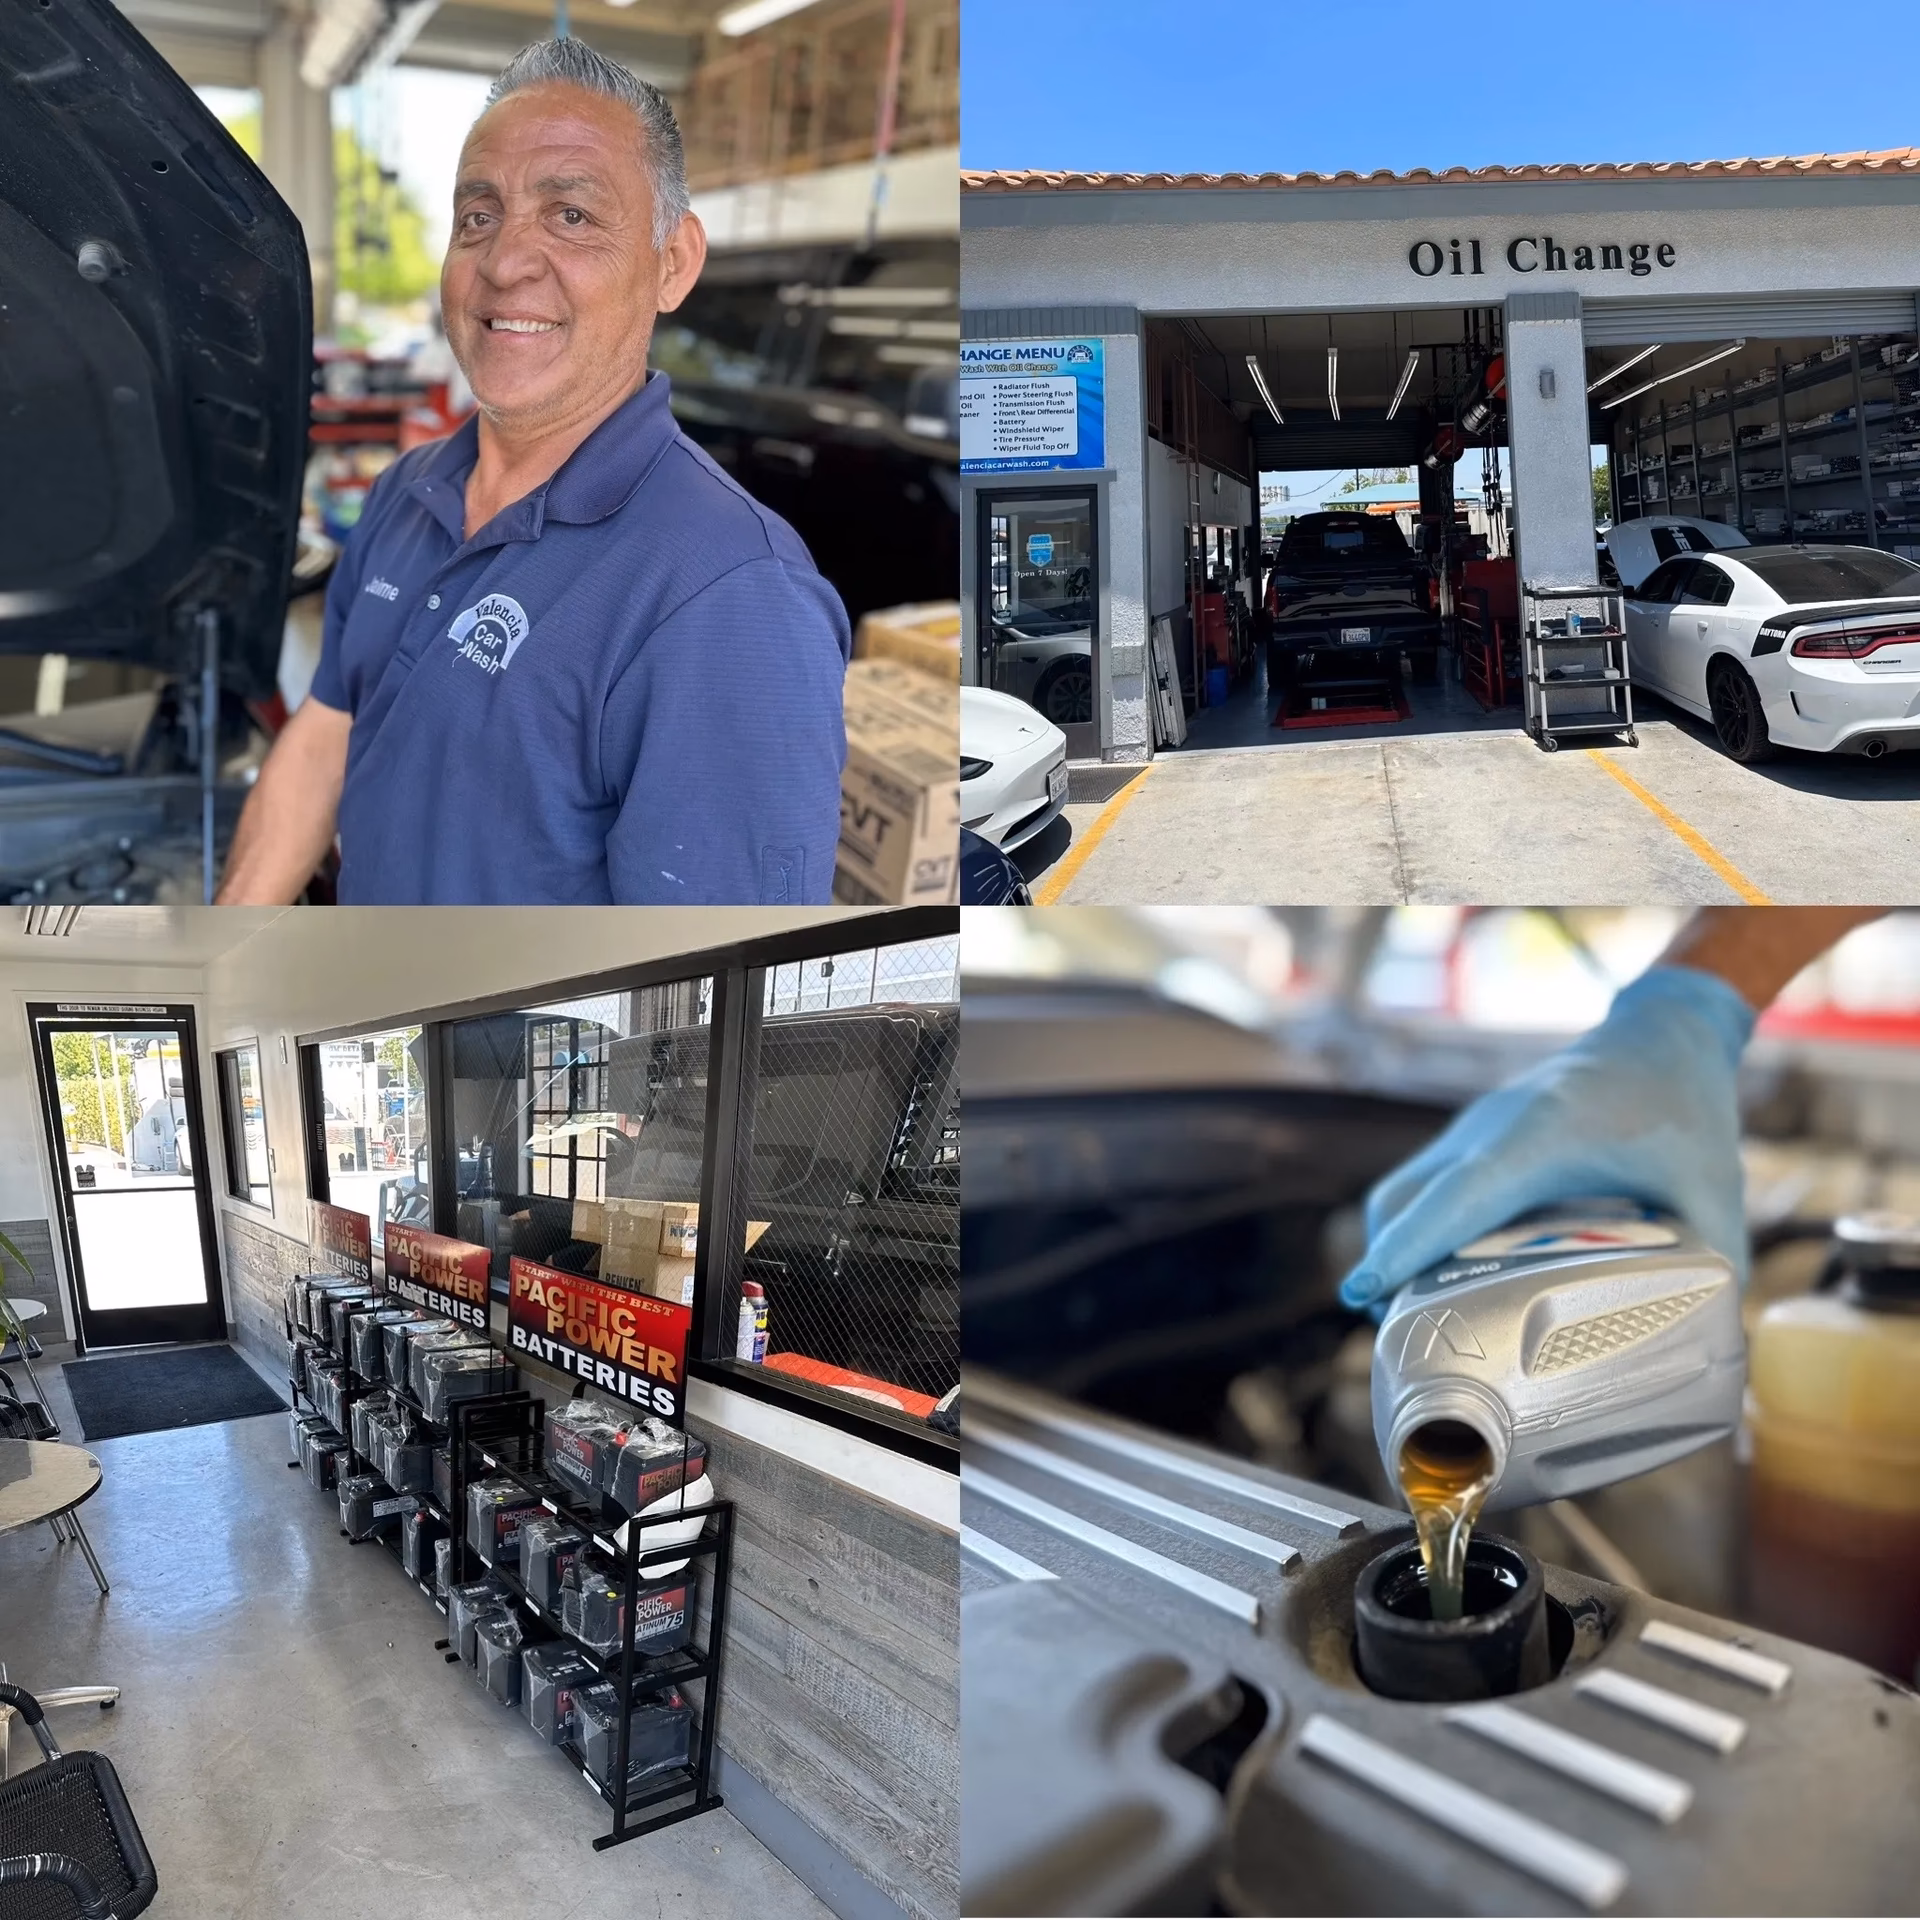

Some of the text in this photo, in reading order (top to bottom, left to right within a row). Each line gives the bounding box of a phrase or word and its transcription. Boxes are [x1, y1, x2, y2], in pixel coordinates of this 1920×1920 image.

[1408, 237, 1676, 276] Oil Change
[1016, 347, 1065, 360] MENU
[960, 362, 1058, 373] Wash With Oil Change
[998, 400, 1045, 408] Transmission
[1022, 391, 1053, 399] Steering
[998, 426, 1041, 434] Windshield
[1042, 443, 1055, 451] Top
[960, 460, 1049, 470] alenciacarwash.com
[1667, 526, 1694, 554] HE
[1046, 568, 1068, 577] Days!
[476, 599, 521, 640] Valencia
[474, 624, 502, 649] Car
[1760, 627, 1786, 639] DAYTONA
[462, 639, 500, 674] Wash
[841, 787, 893, 843] VT
[323, 1229, 367, 1260] POWER
[388, 1234, 463, 1275] PACIFIC
[409, 1260, 486, 1304] POWER
[388, 1275, 485, 1328] BATTERIES
[515, 1273, 636, 1337] PACIFIC
[561, 1277, 595, 1294] WITH
[597, 1288, 626, 1304] THE
[630, 1298, 674, 1317] BEST
[547, 1309, 677, 1383] POWER
[513, 1324, 675, 1416] BATTERIES
[562, 1437, 584, 1461] POWER
[580, 1466, 592, 1482] 75
[644, 1468, 682, 1488] PACIFIC
[501, 1508, 537, 1522] PACIFIC
[636, 1596, 662, 1612] CIFIC
[638, 1602, 672, 1621] POWER
[636, 1617, 667, 1634] ATINUM
[667, 1612, 683, 1628] 75
